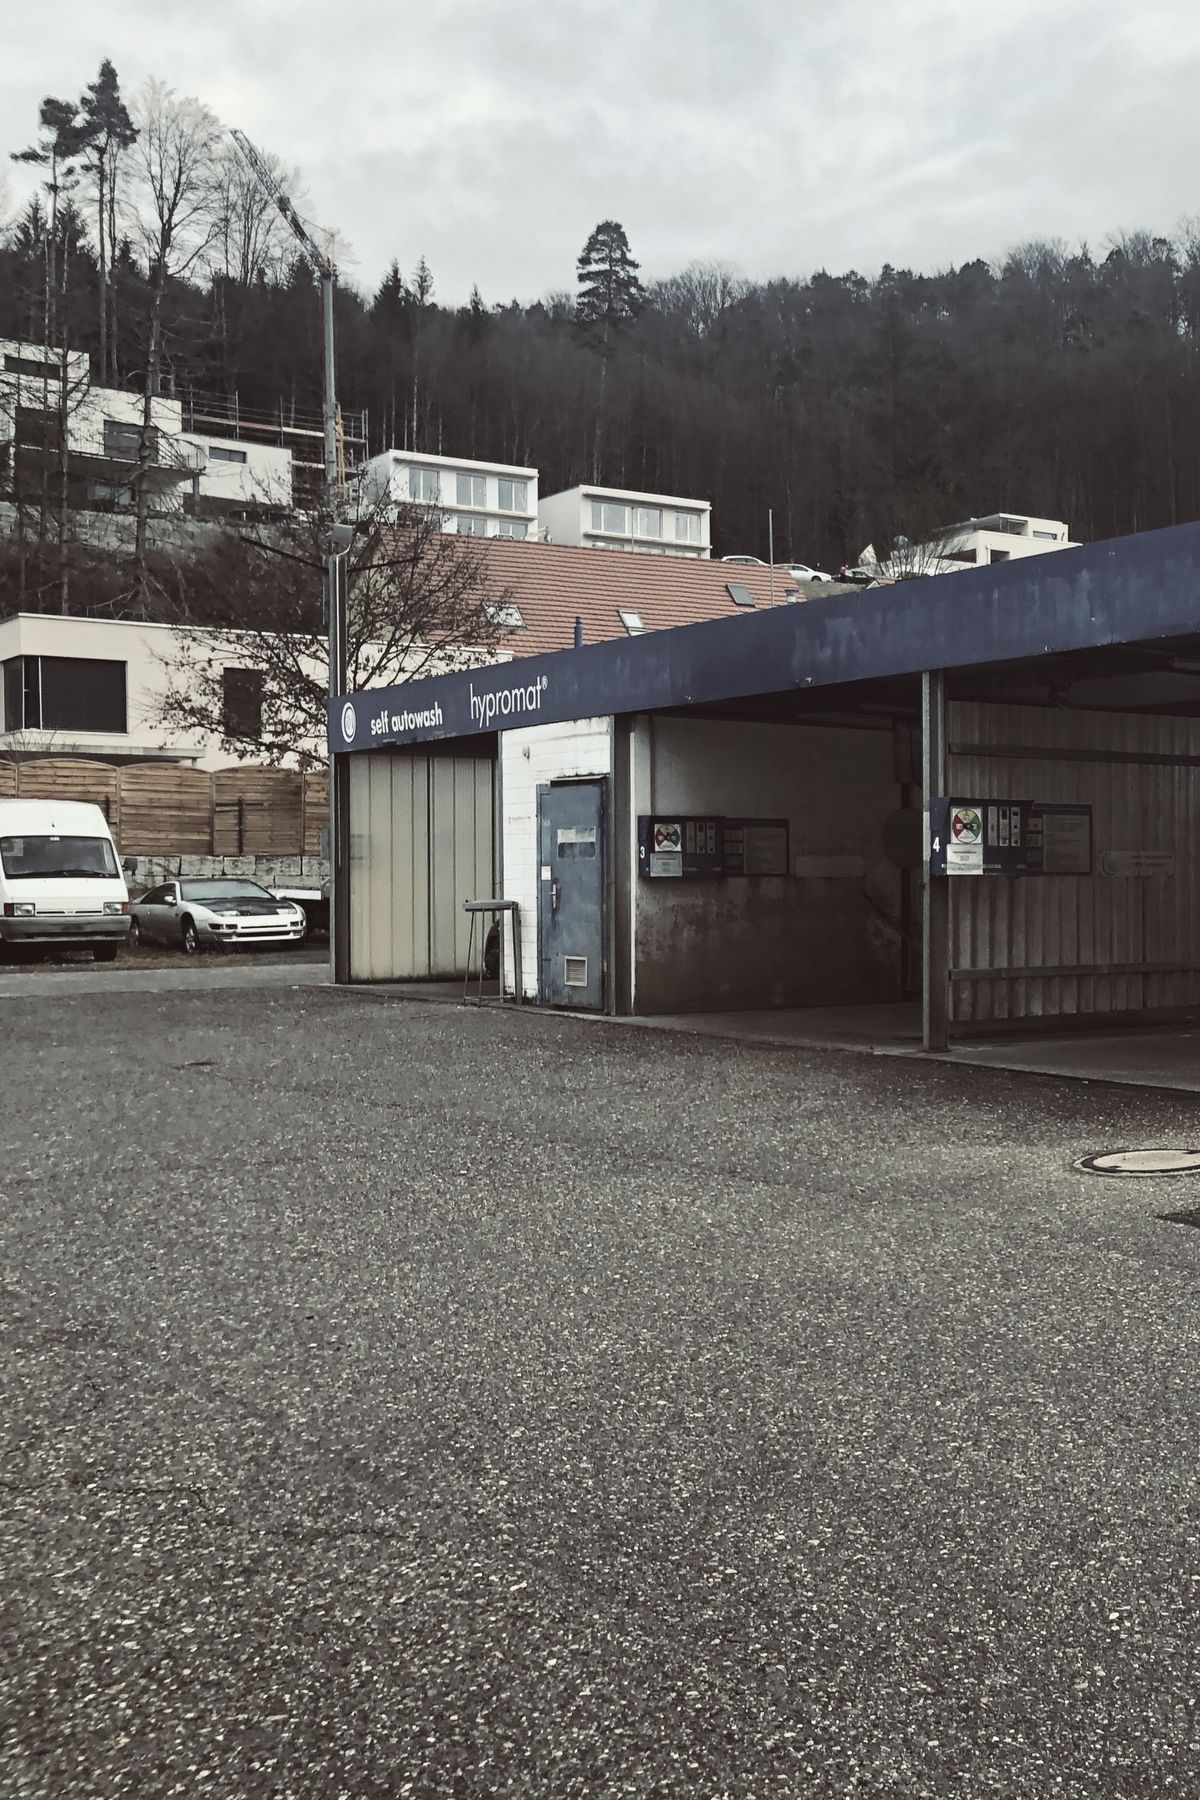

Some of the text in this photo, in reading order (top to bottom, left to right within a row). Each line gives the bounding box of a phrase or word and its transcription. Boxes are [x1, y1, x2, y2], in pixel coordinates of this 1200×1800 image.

[370, 701, 443, 735] self autowash
[640, 846, 645, 859] 3
[932, 836, 941, 853] 4
